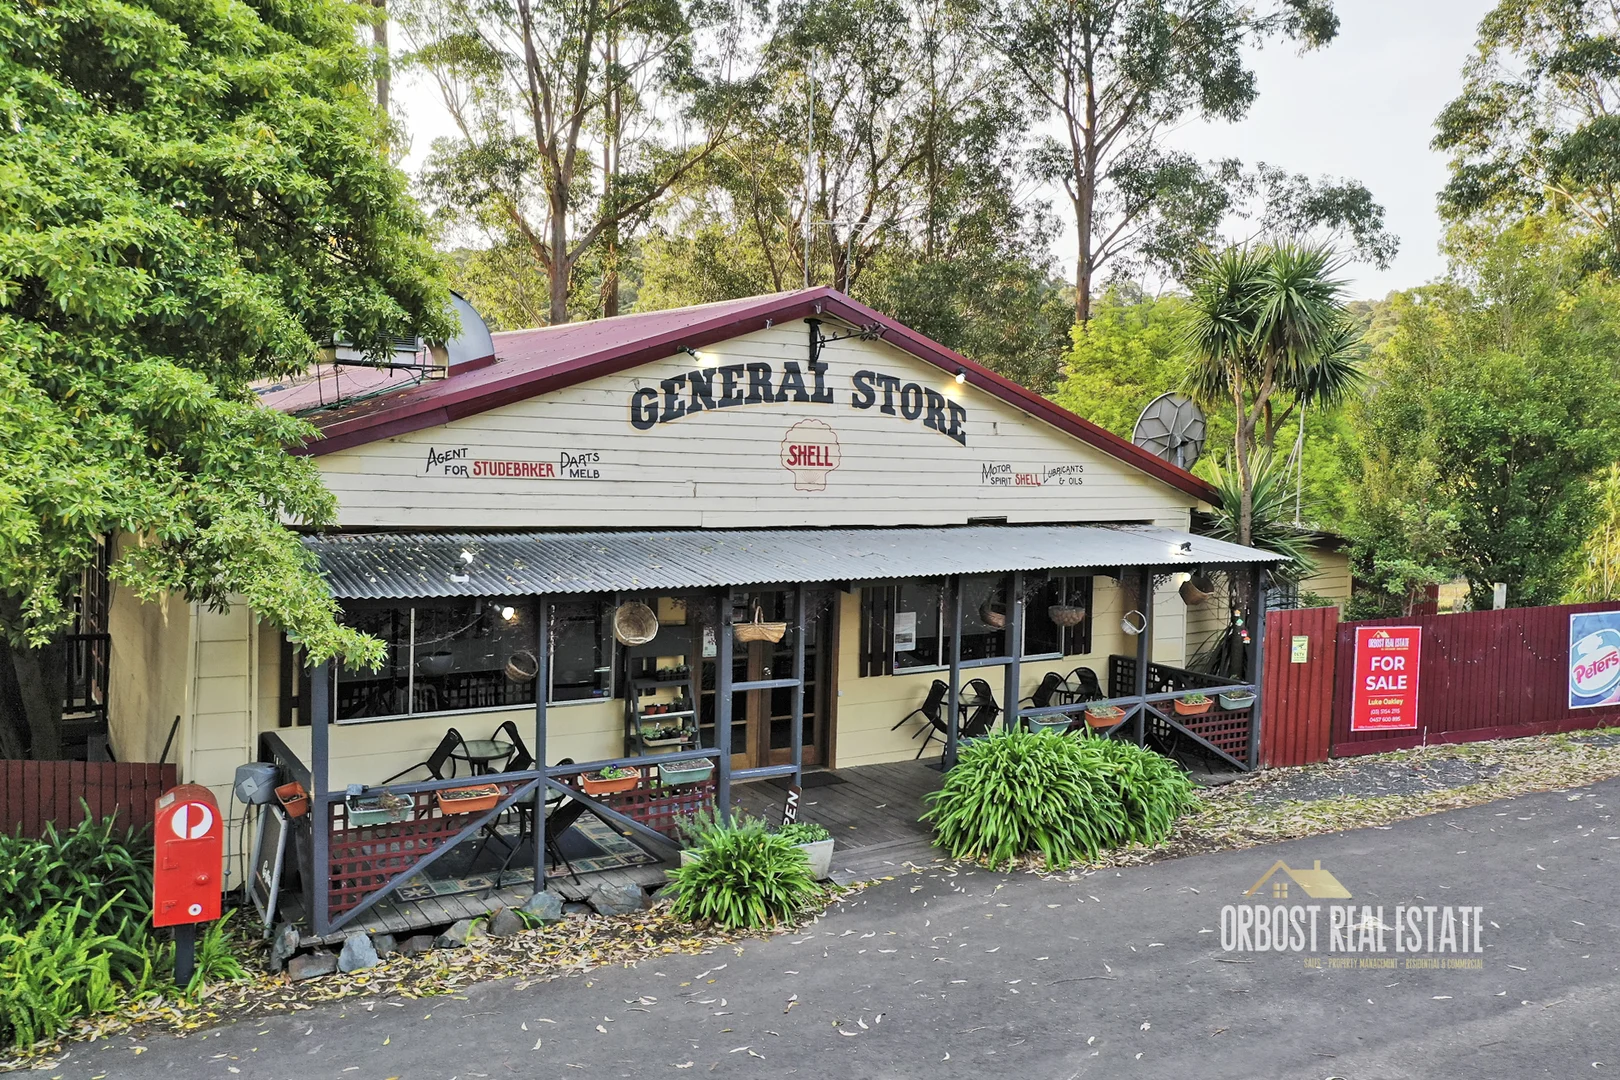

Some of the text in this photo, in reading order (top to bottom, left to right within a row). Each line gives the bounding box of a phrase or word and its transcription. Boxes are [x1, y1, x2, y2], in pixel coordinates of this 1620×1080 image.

[630, 361, 967, 447] GENERAL STORE
[426, 447, 468, 473] AGENT
[560, 451, 600, 476] PARTS
[786, 445, 833, 466] SHELL
[445, 460, 555, 478] FOR STUDEBAKER
[569, 469, 600, 479] MELB
[982, 463, 1012, 484] MOTOR
[1043, 465, 1084, 484] LUBRICANTS
[990, 473, 1041, 487] SPIRIT SHELL
[1068, 477, 1083, 485] OILS
[1370, 656, 1405, 671] FOR
[1573, 651, 1620, 684] Peters
[1366, 675, 1407, 691] SALE
[1383, 698, 1404, 706] Oakley
[782, 790, 799, 825] PEN
